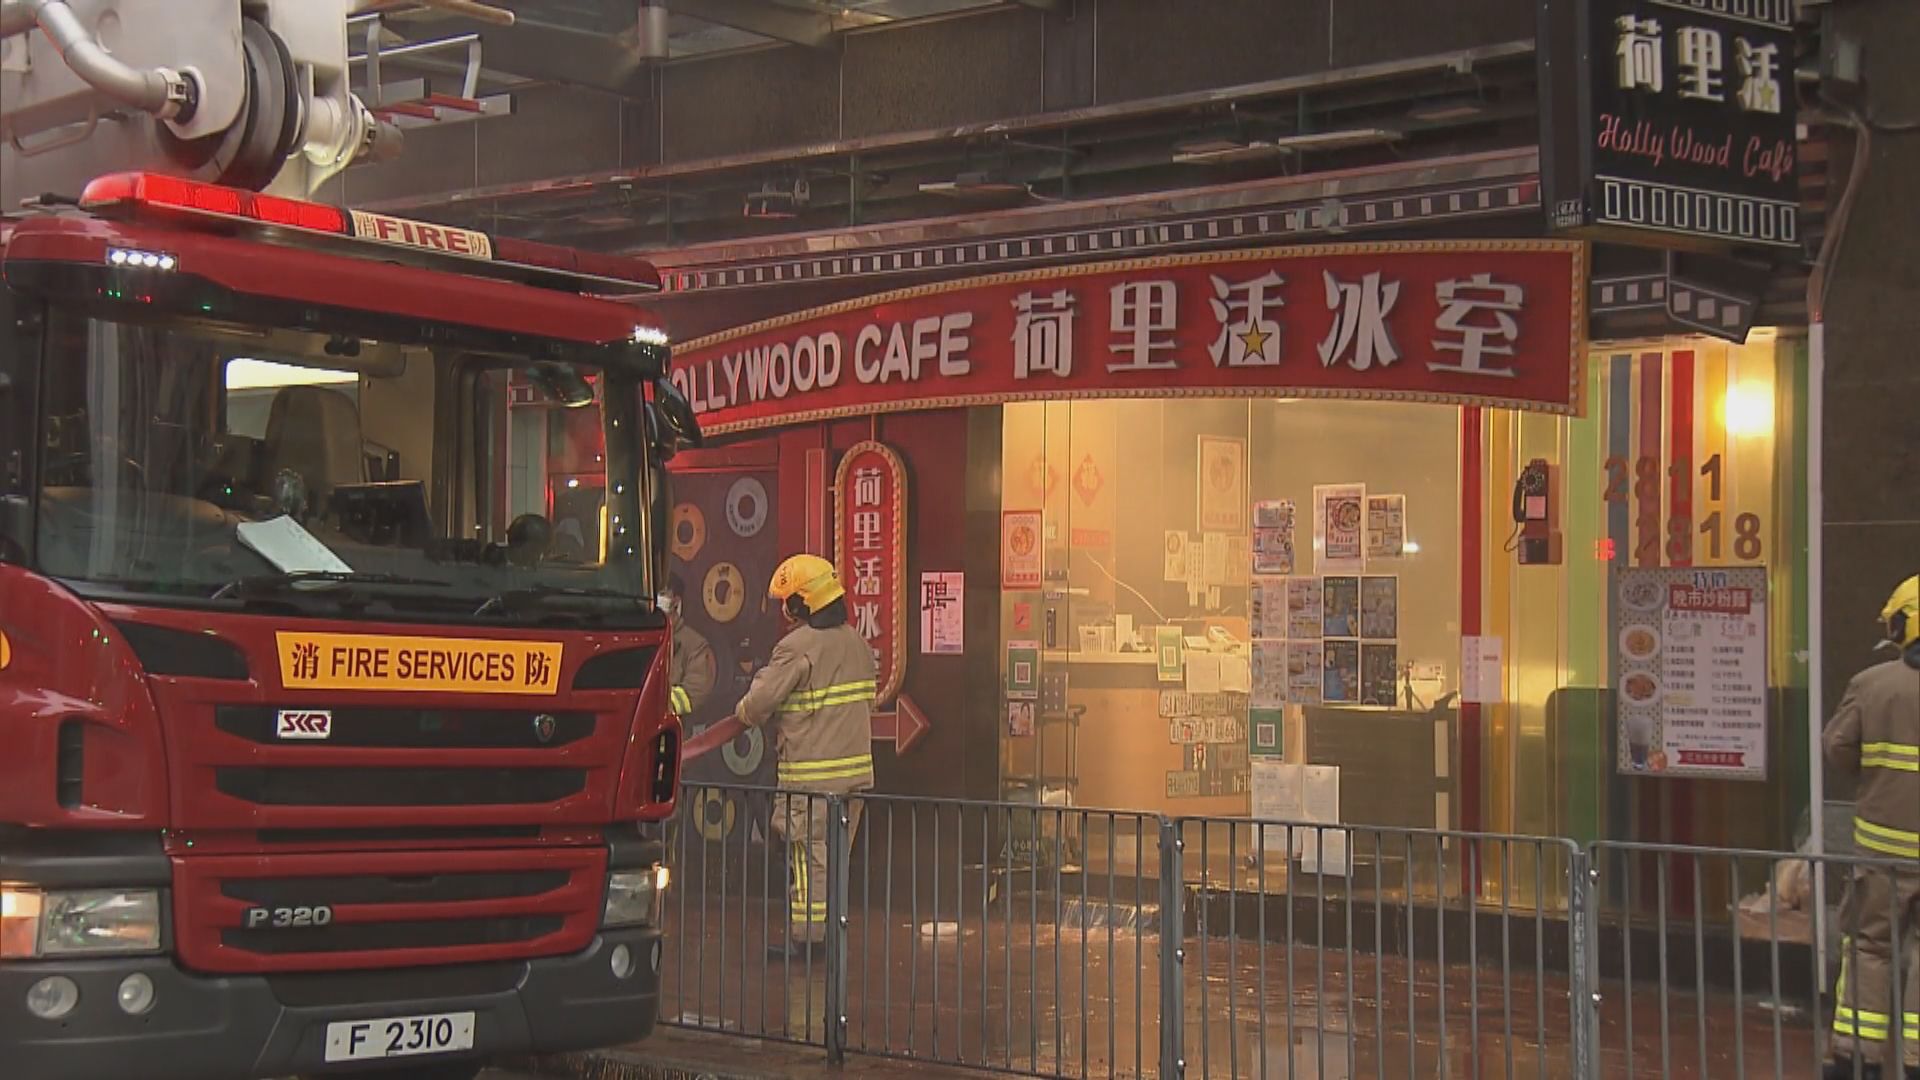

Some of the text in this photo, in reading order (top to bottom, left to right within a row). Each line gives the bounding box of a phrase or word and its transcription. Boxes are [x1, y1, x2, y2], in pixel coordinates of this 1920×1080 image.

[1615, 14, 1781, 114] 荷里活
[1599, 113, 1664, 167] Holly
[1671, 126, 1732, 168] Wood
[376, 218, 470, 253] FIRE
[672, 269, 1524, 413] OLLYWOOD CAFE 荷里活冰室
[292, 642, 552, 686] 消 FIRE SERVICES 防
[248, 906, 332, 928] P 320
[349, 1018, 452, 1055] F 2310
